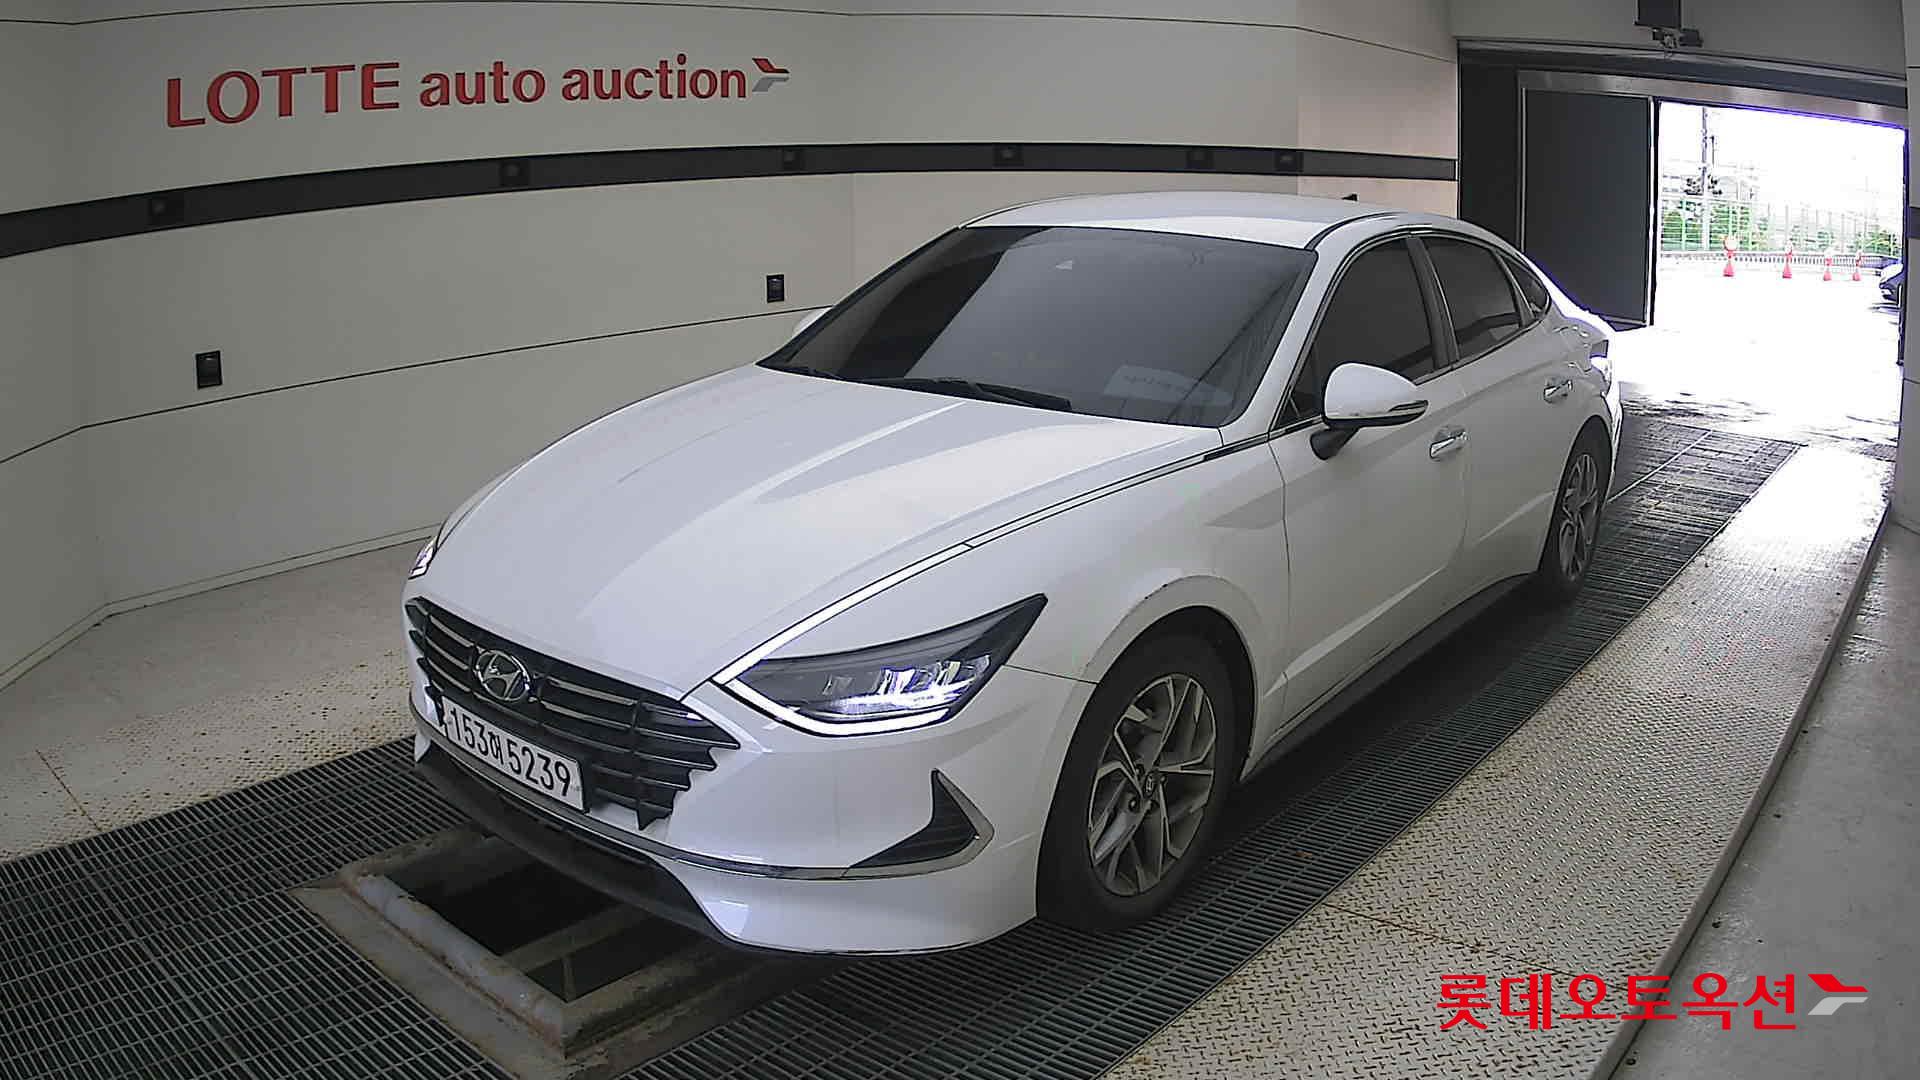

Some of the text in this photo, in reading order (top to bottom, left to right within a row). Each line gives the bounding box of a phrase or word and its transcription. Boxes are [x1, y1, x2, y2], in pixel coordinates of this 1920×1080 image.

[166, 53, 747, 128] LOTTE auto auction
